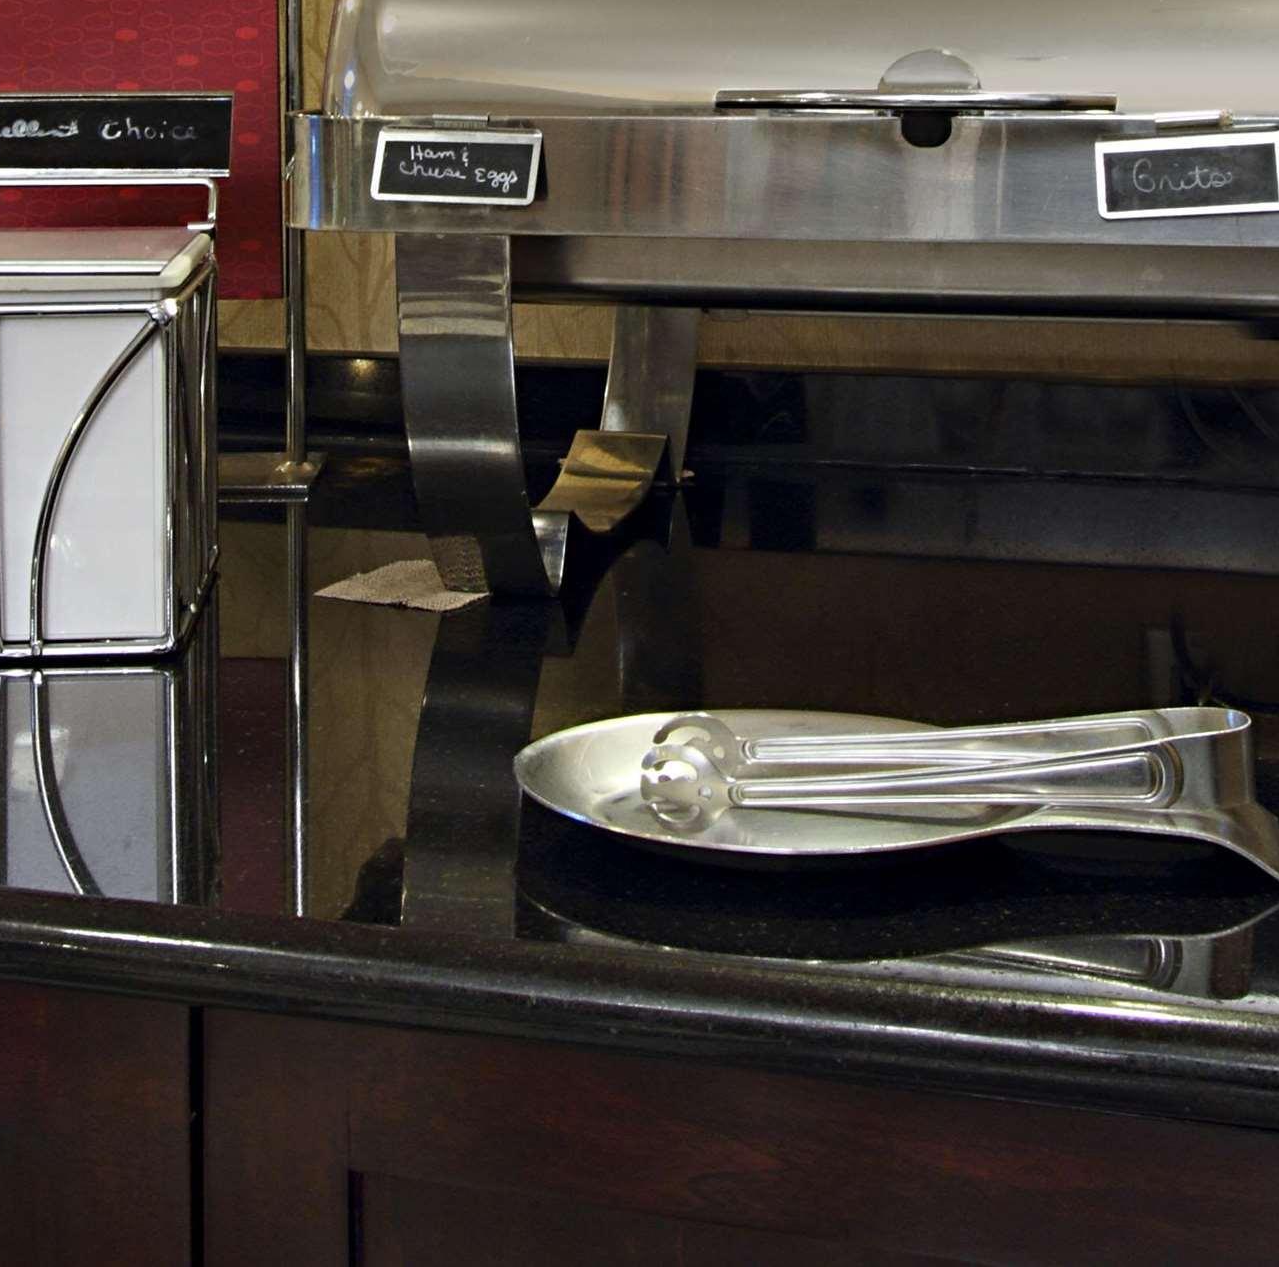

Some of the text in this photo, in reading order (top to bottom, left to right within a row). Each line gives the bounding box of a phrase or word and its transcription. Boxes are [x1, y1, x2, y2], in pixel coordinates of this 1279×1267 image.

[410, 145, 455, 161] Ham
[474, 168, 518, 193] Eggs
[1132, 158, 1233, 193] Grits
